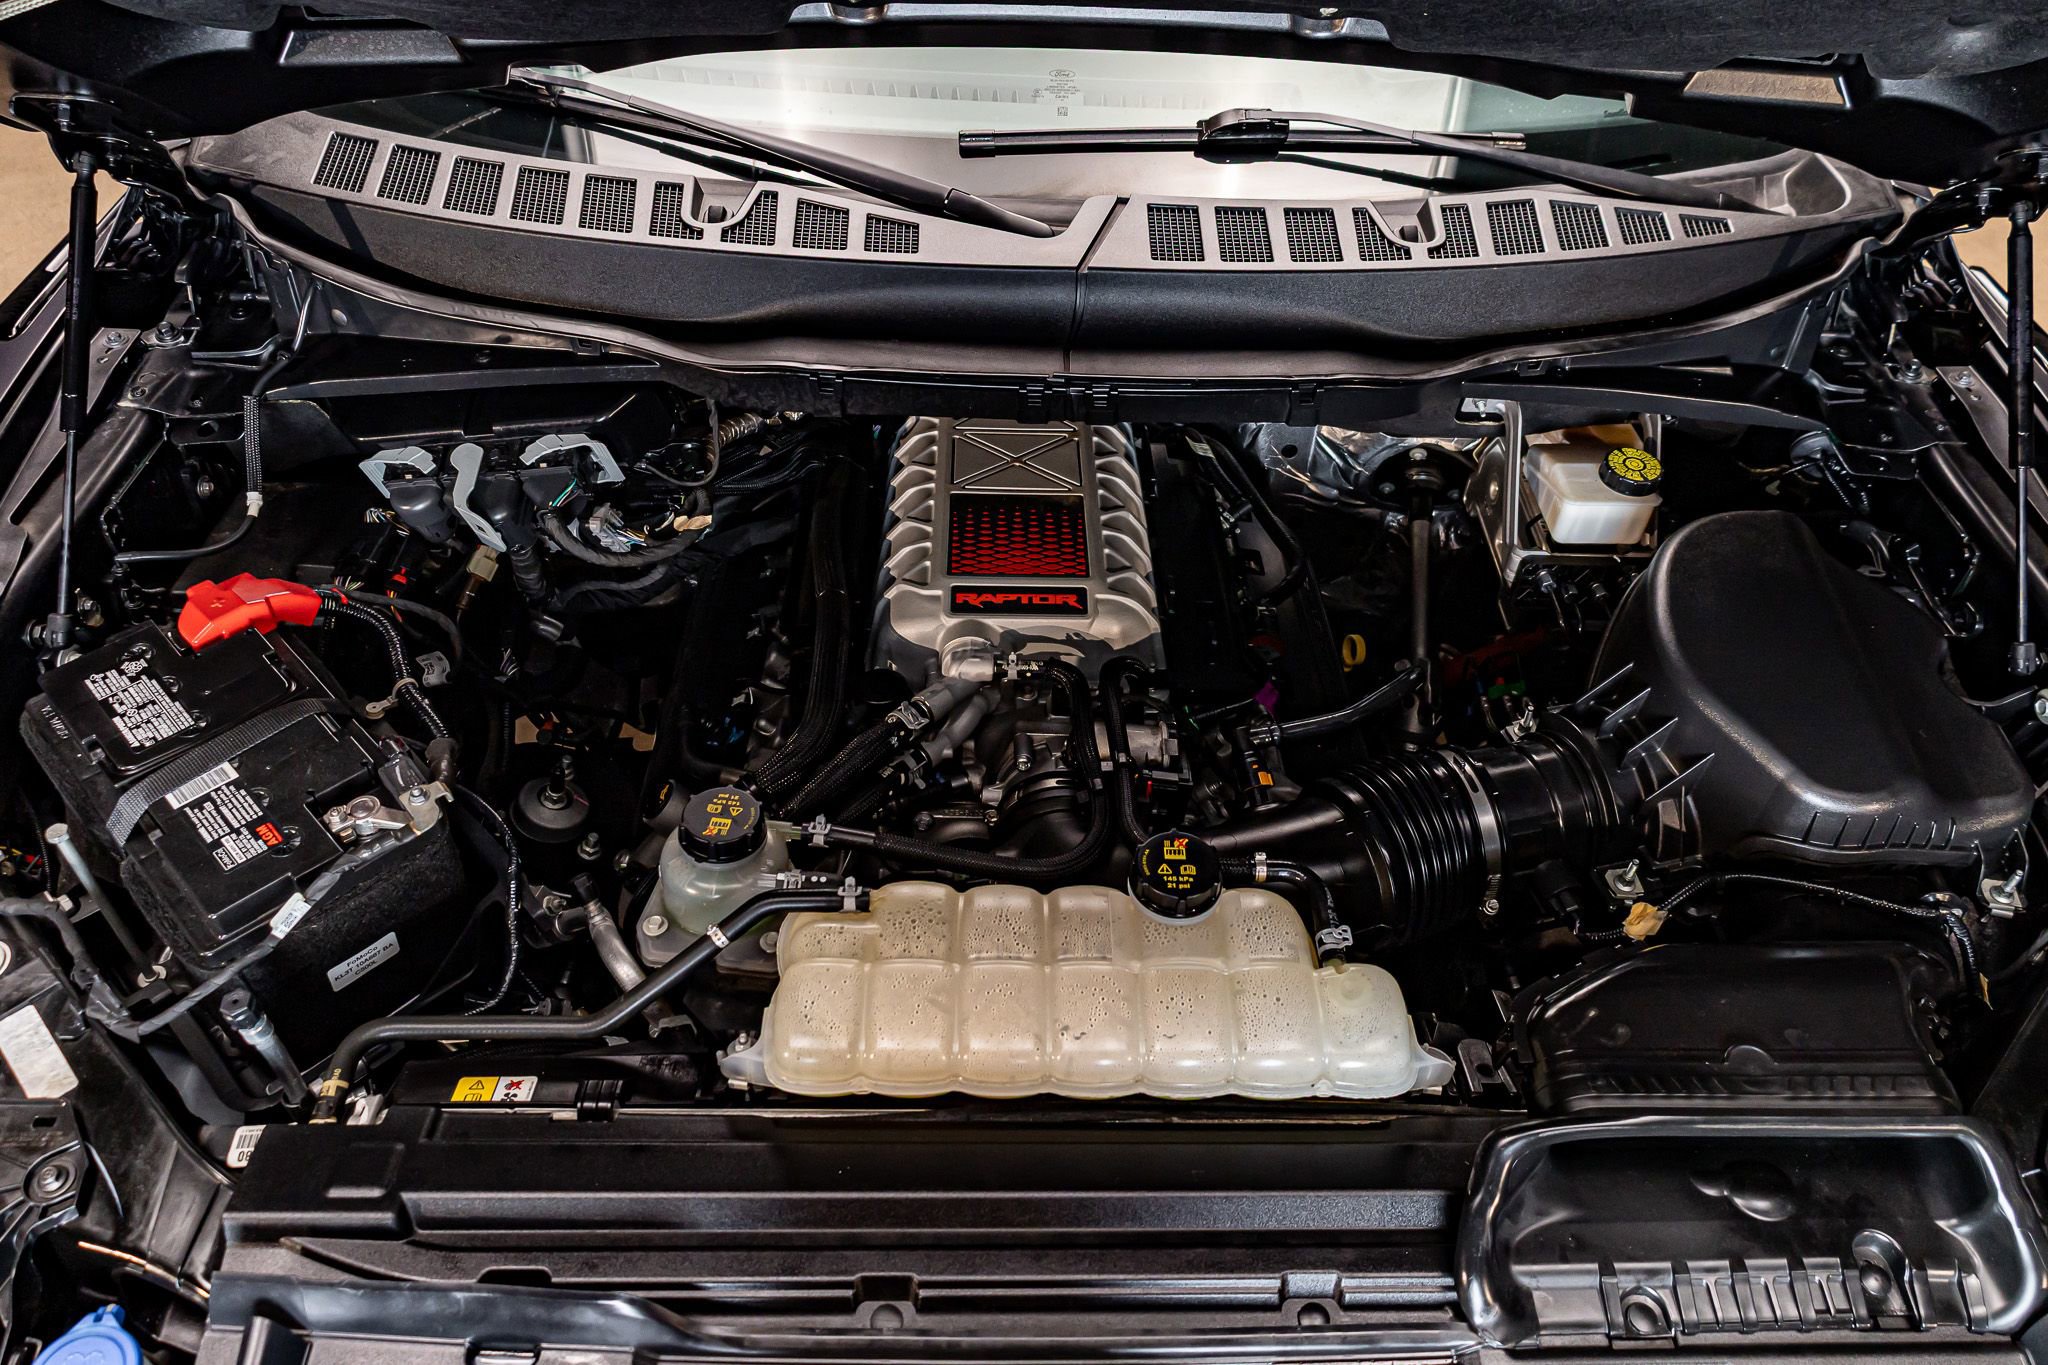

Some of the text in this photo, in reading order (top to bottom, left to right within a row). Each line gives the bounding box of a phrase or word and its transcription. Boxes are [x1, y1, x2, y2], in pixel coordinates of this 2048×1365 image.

[955, 592, 1083, 609] RAPTOR
[255, 823, 279, 847] AGM
[334, 966, 353, 982] KL3T
[382, 942, 394, 952] BA
[346, 946, 378, 967] FoMoCo
